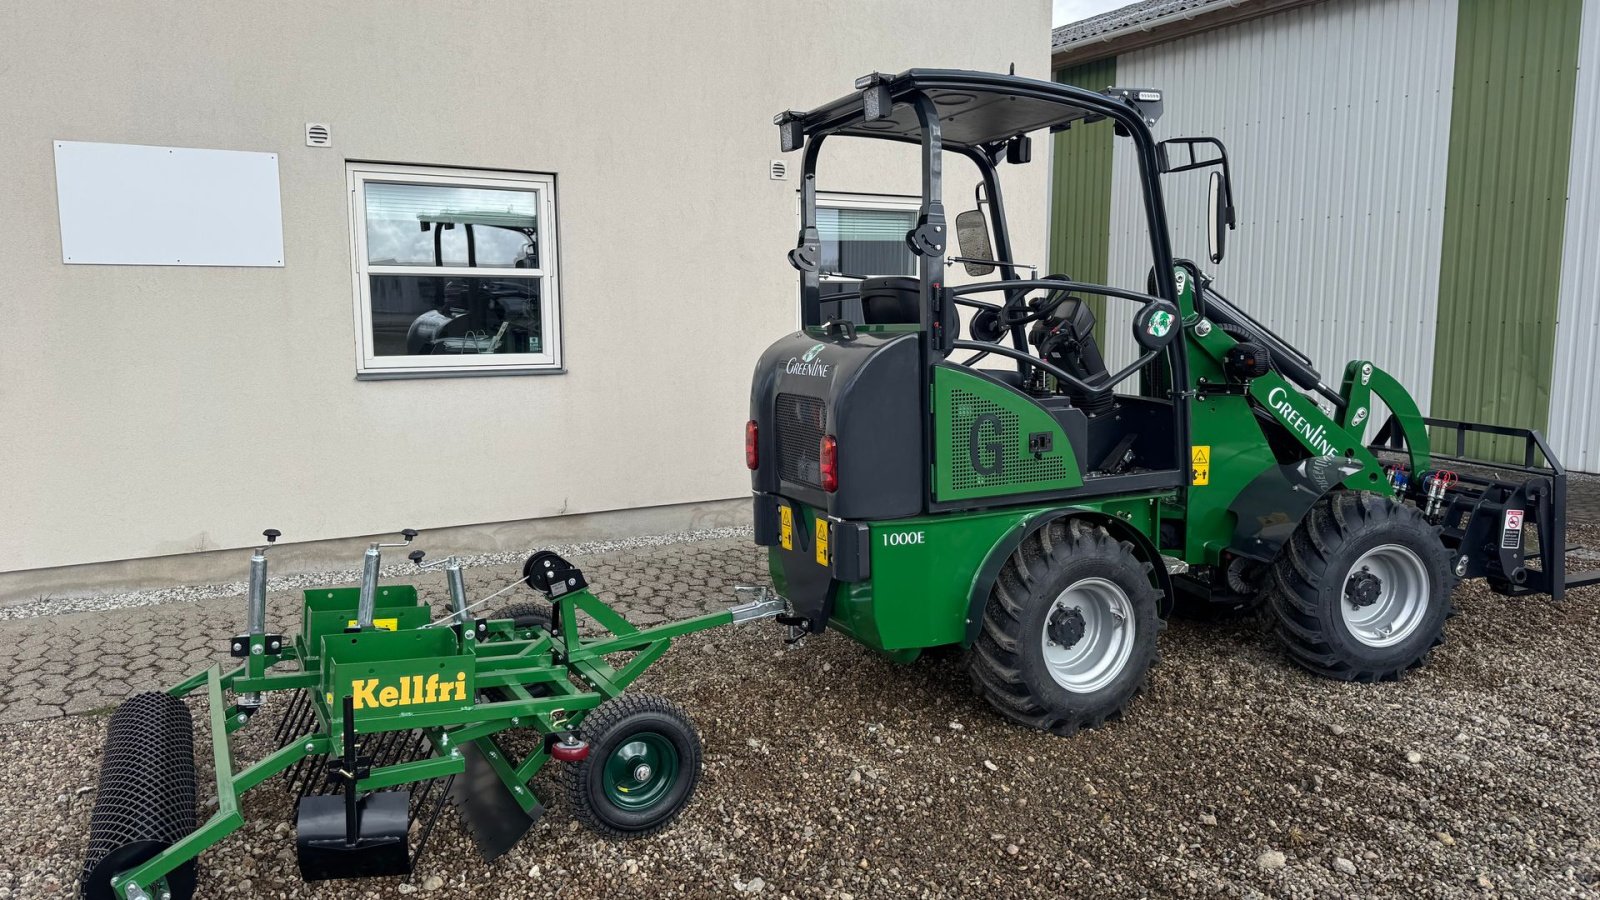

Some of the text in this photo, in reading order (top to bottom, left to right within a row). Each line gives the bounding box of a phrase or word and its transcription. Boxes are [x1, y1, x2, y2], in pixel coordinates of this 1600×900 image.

[970, 412, 1003, 476] G
[882, 531, 926, 547] 1000E
[351, 671, 467, 710] Kellfri
